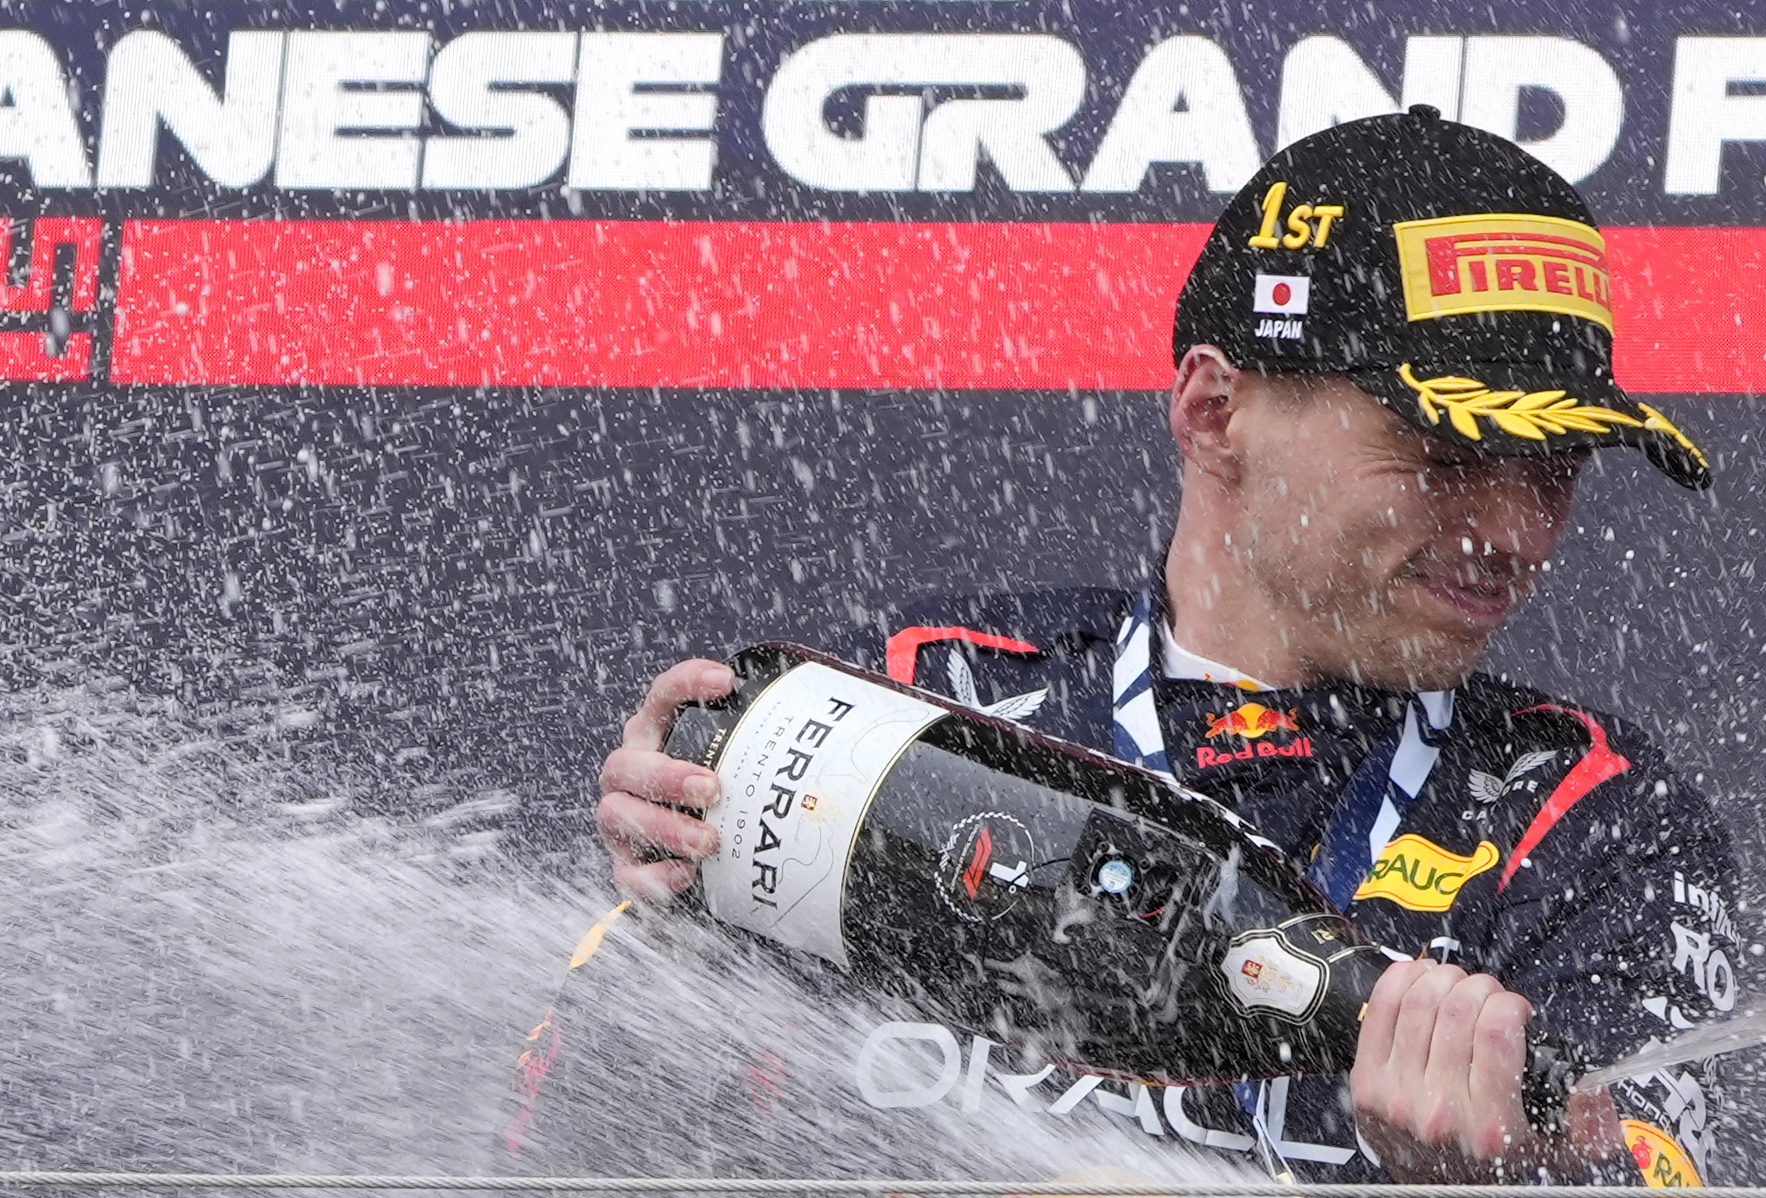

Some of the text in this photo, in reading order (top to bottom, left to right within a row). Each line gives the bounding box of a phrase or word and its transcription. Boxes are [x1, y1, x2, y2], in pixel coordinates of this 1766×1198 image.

[761, 33, 1624, 195] GRAND
[1248, 182, 1345, 250] 1ST
[1255, 319, 1302, 340] JAPAN
[703, 727, 728, 768] TRENT
[744, 714, 796, 799] TRENTO
[1196, 737, 1314, 769] Red Bull
[751, 696, 857, 911] FERRARI
[730, 810, 749, 860] 1902
[1366, 853, 1465, 896] RAUC
[855, 1020, 1358, 1165] ORACL
